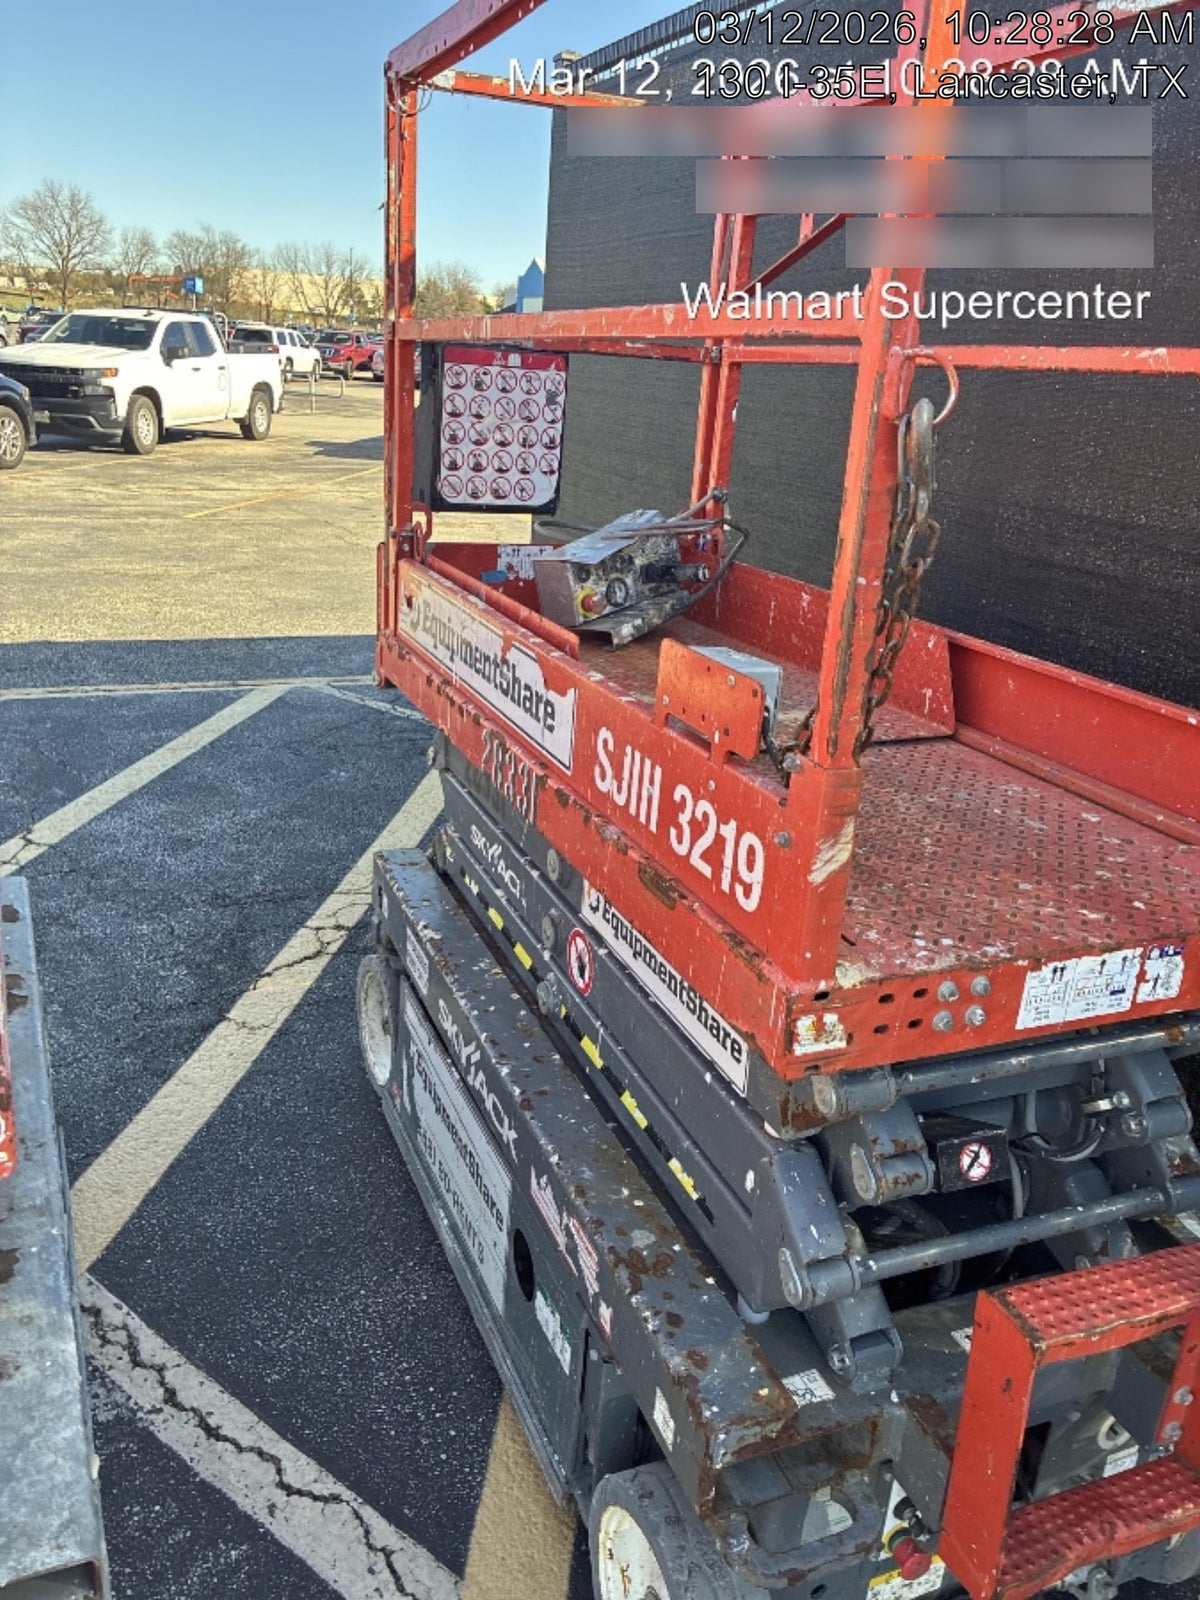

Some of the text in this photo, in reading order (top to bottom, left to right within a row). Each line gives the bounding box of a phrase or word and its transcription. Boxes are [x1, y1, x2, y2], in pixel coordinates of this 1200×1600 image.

[422, 599, 556, 734] EquipmentShare
[669, 784, 765, 912] 3219
[602, 899, 743, 1064] EquipmentShare
[438, 998, 518, 1163] SKYJACK
